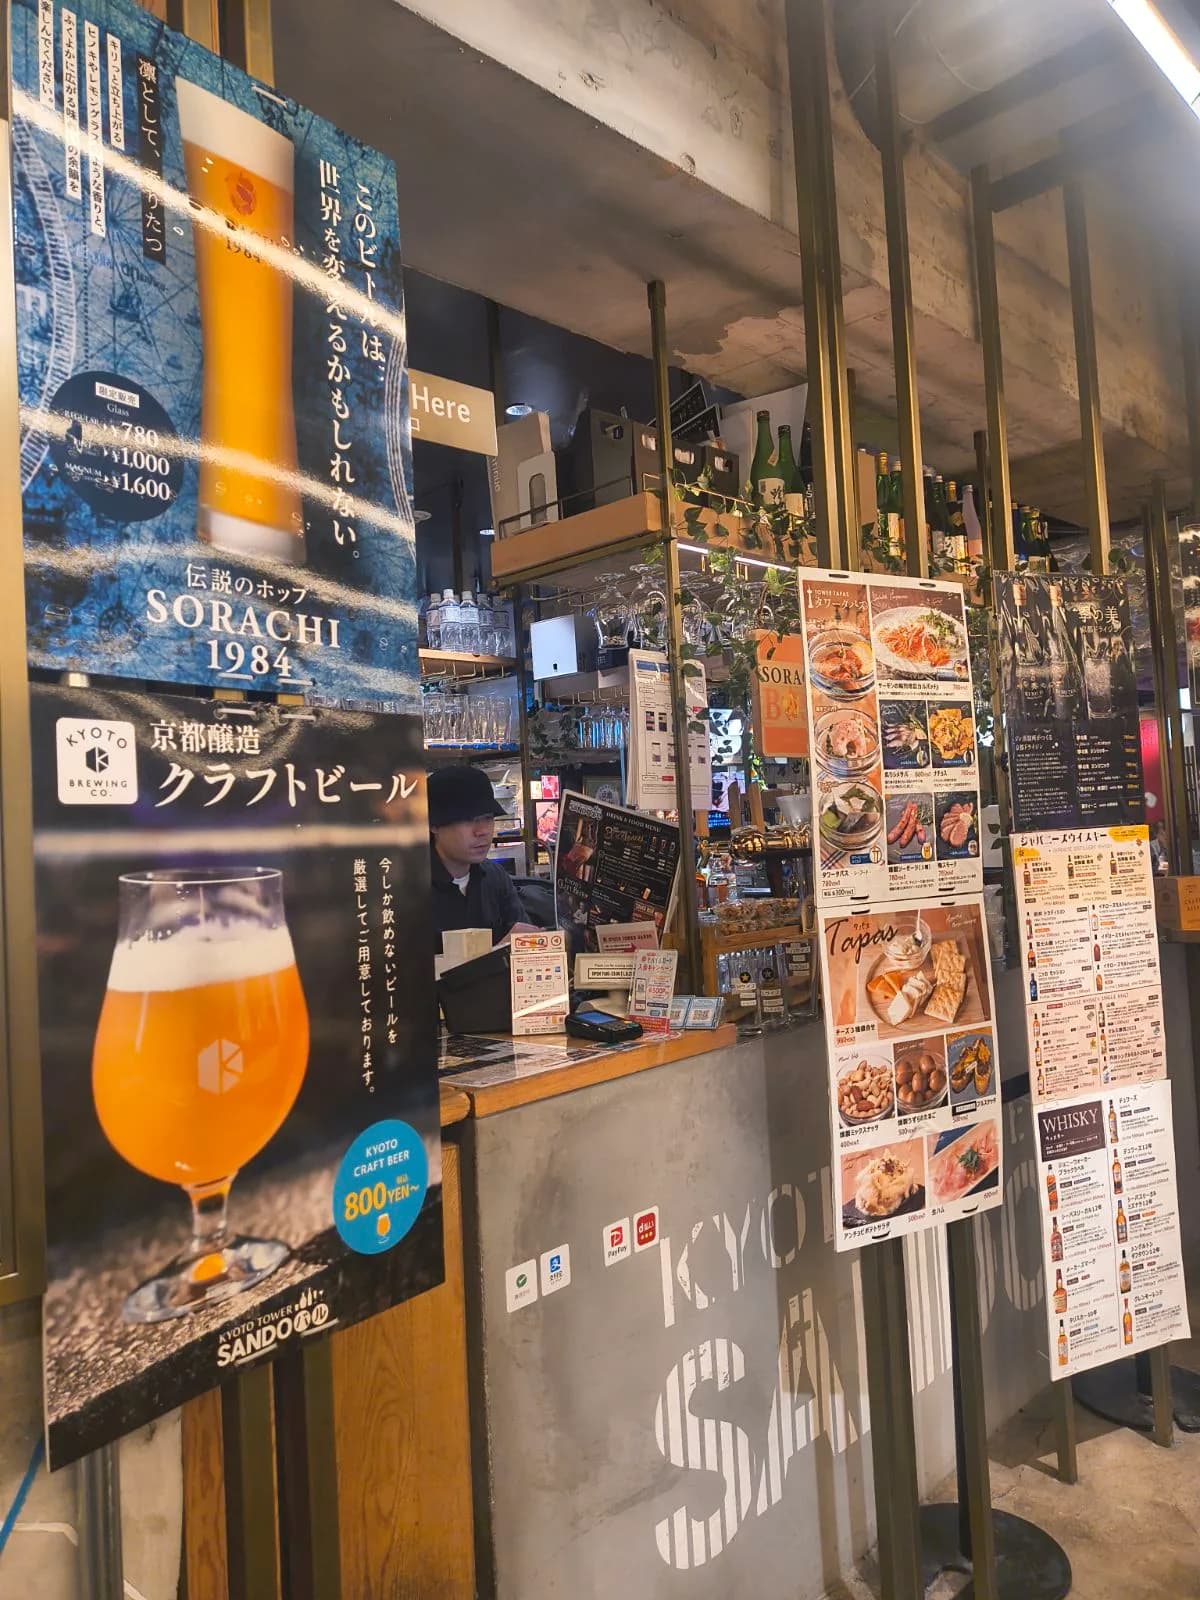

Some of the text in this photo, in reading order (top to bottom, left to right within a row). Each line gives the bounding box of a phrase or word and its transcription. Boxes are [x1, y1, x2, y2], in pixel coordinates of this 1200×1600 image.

[63, 14, 80, 193] ふくよかに広がる味の余韻を
[106, 402, 130, 417] Glass
[411, 382, 472, 424] Here
[147, 589, 341, 649] SORACHI
[207, 638, 293, 677] 1984
[761, 664, 805, 686] SORA
[66, 726, 128, 749] KYOTO
[150, 718, 262, 755] 京都醸造
[68, 778, 128, 789] BREWING
[90, 788, 113, 798] CO.
[154, 762, 419, 808] クラフトビール
[379, 856, 399, 1044] 今しか飲めないビールを
[823, 918, 899, 965] Tapas
[353, 858, 375, 1093] 厳選してご用意しております。
[1042, 1108, 1099, 1134] WHISKY
[353, 1150, 410, 1178] CRAFT BEER
[365, 1138, 399, 1158] KYOTO
[607, 1245, 628, 1258] PayPay
[219, 1304, 293, 1344] KYOTO TOWER
